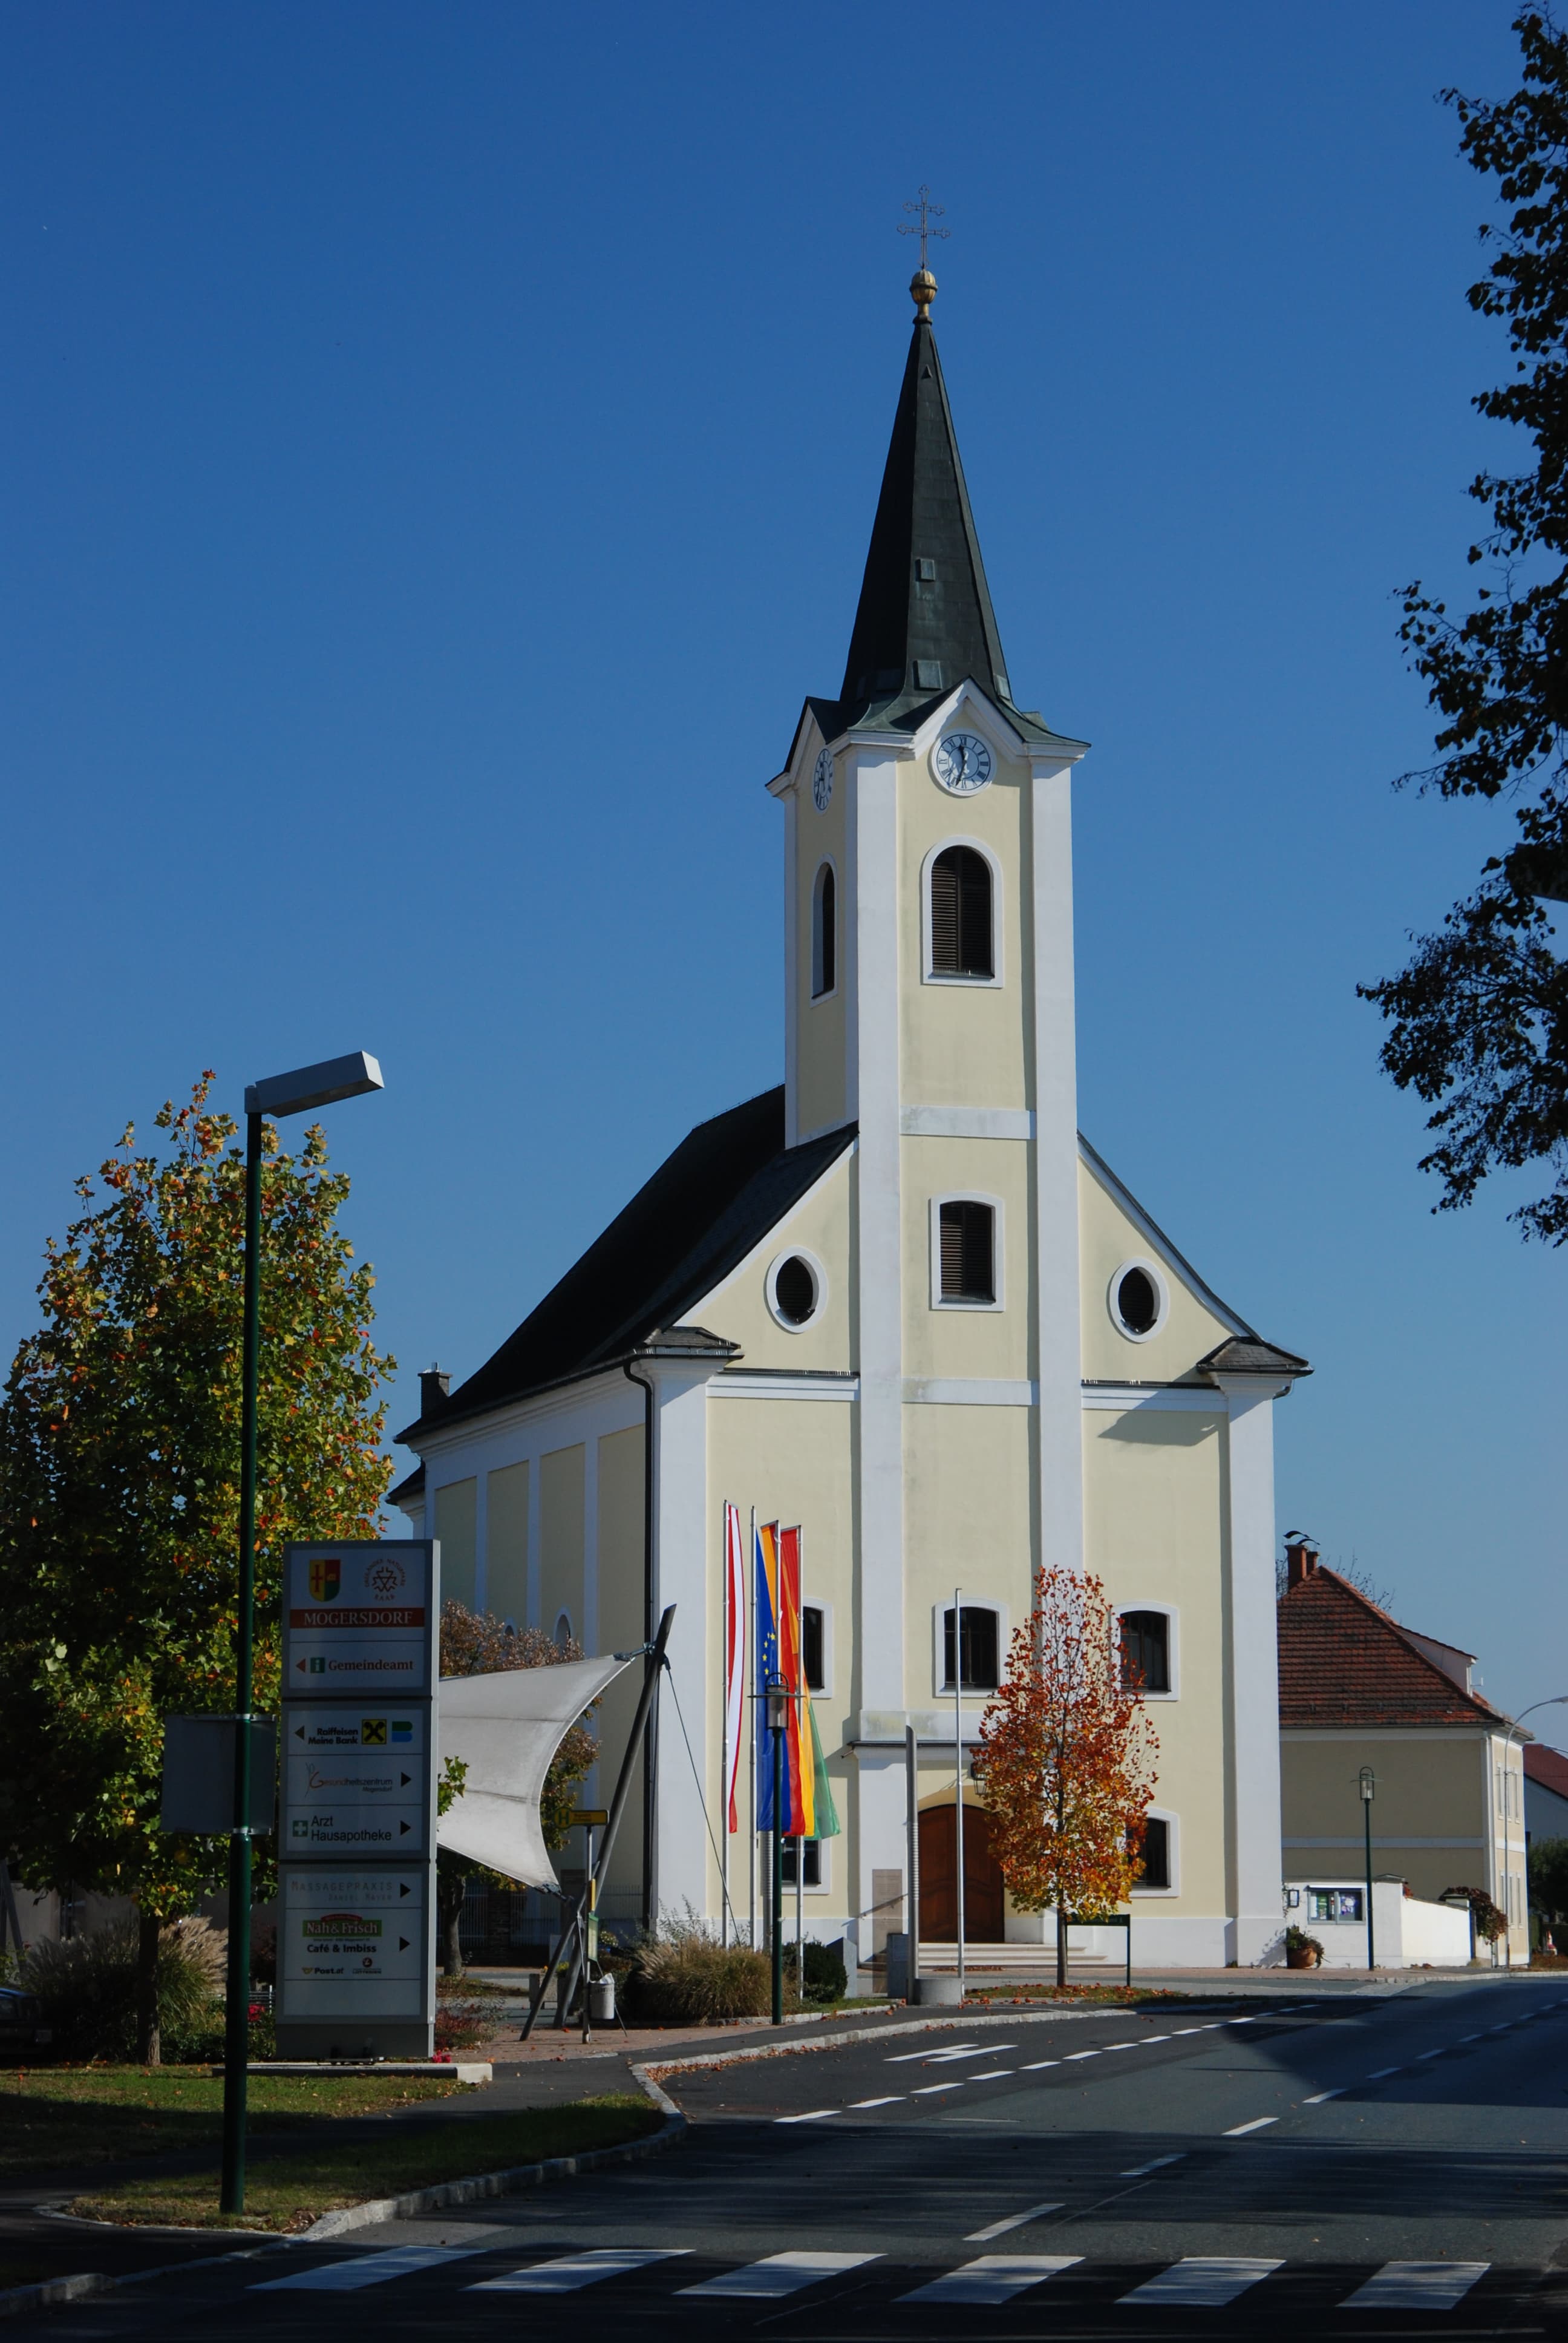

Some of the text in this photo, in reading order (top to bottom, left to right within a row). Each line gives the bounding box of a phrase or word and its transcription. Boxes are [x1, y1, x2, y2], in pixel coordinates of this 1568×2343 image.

[304, 1611, 413, 1626] MOGERSDORF
[328, 1659, 414, 1671] Gemeindeamt
[317, 1728, 359, 1736] Raiffeisen
[308, 1736, 358, 1745] Meine Bank
[310, 1771, 393, 1788] Gesundheitszentrum
[311, 1815, 333, 1827] Arzt
[311, 1829, 392, 1843] Hausapotheke
[290, 1881, 393, 1892] MASSAGEPRAXIS
[342, 1921, 377, 1934] Frisch
[307, 1944, 376, 1953] Café & Imbiss
